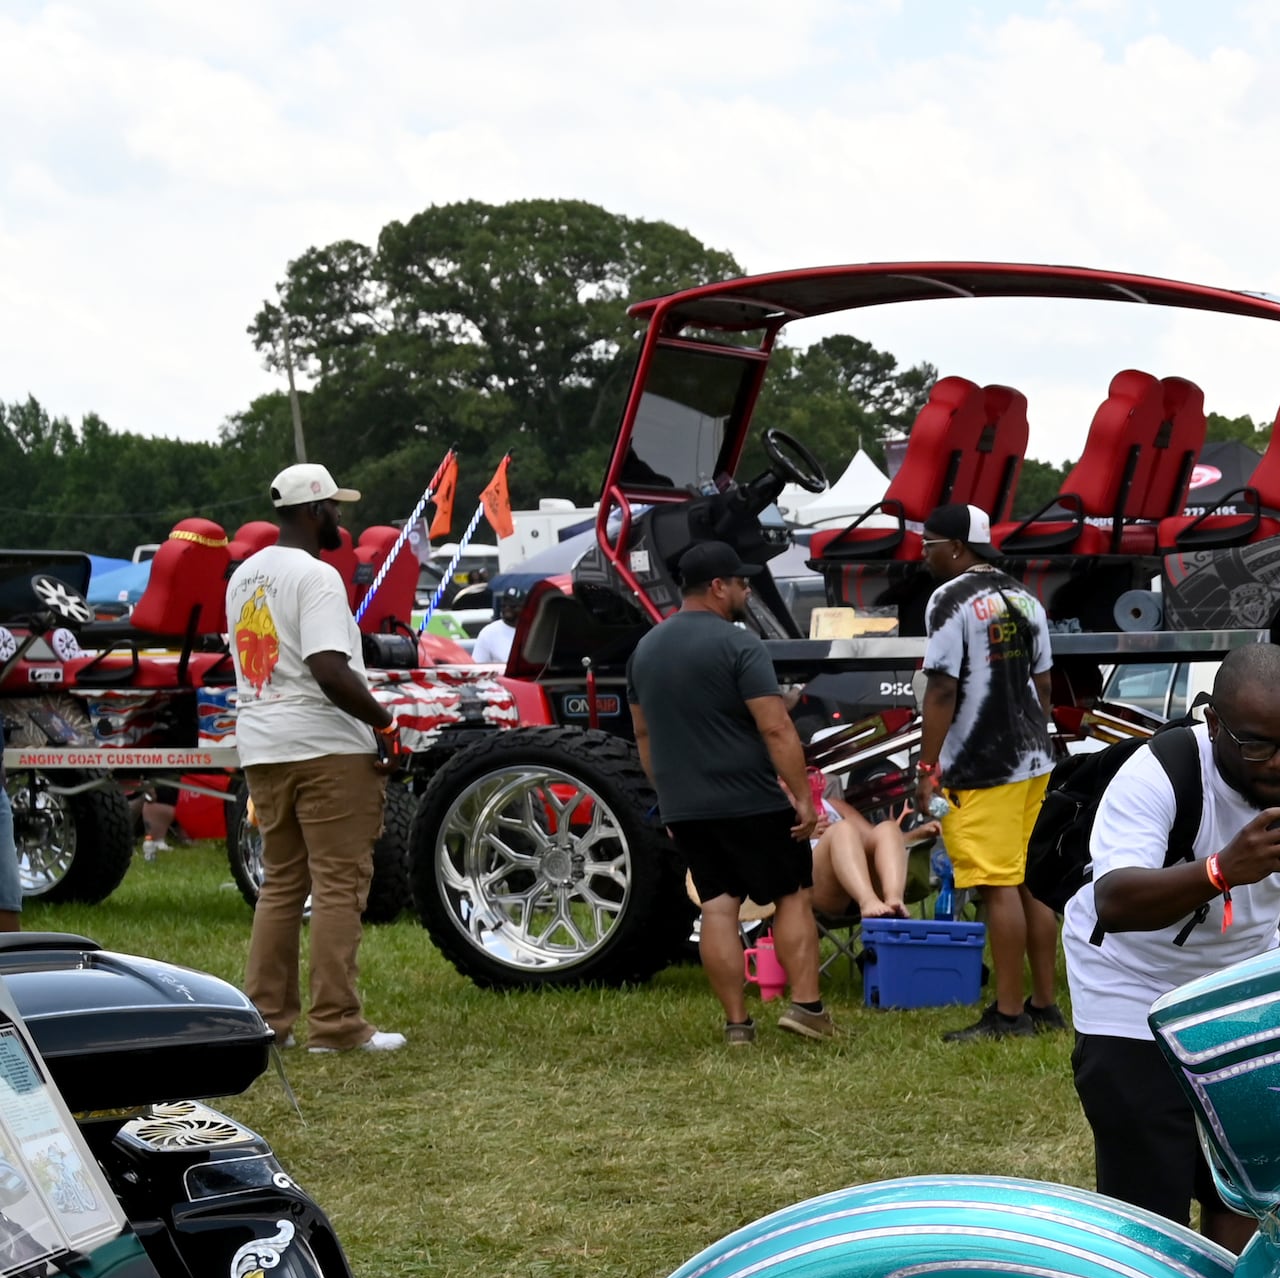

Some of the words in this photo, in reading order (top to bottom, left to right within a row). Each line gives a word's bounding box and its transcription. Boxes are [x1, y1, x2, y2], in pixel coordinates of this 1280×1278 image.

[19, 753, 63, 765] ANGRY
[68, 753, 103, 765] GOAT
[107, 753, 163, 765] CUSTOM
[167, 753, 212, 764] CARTS
